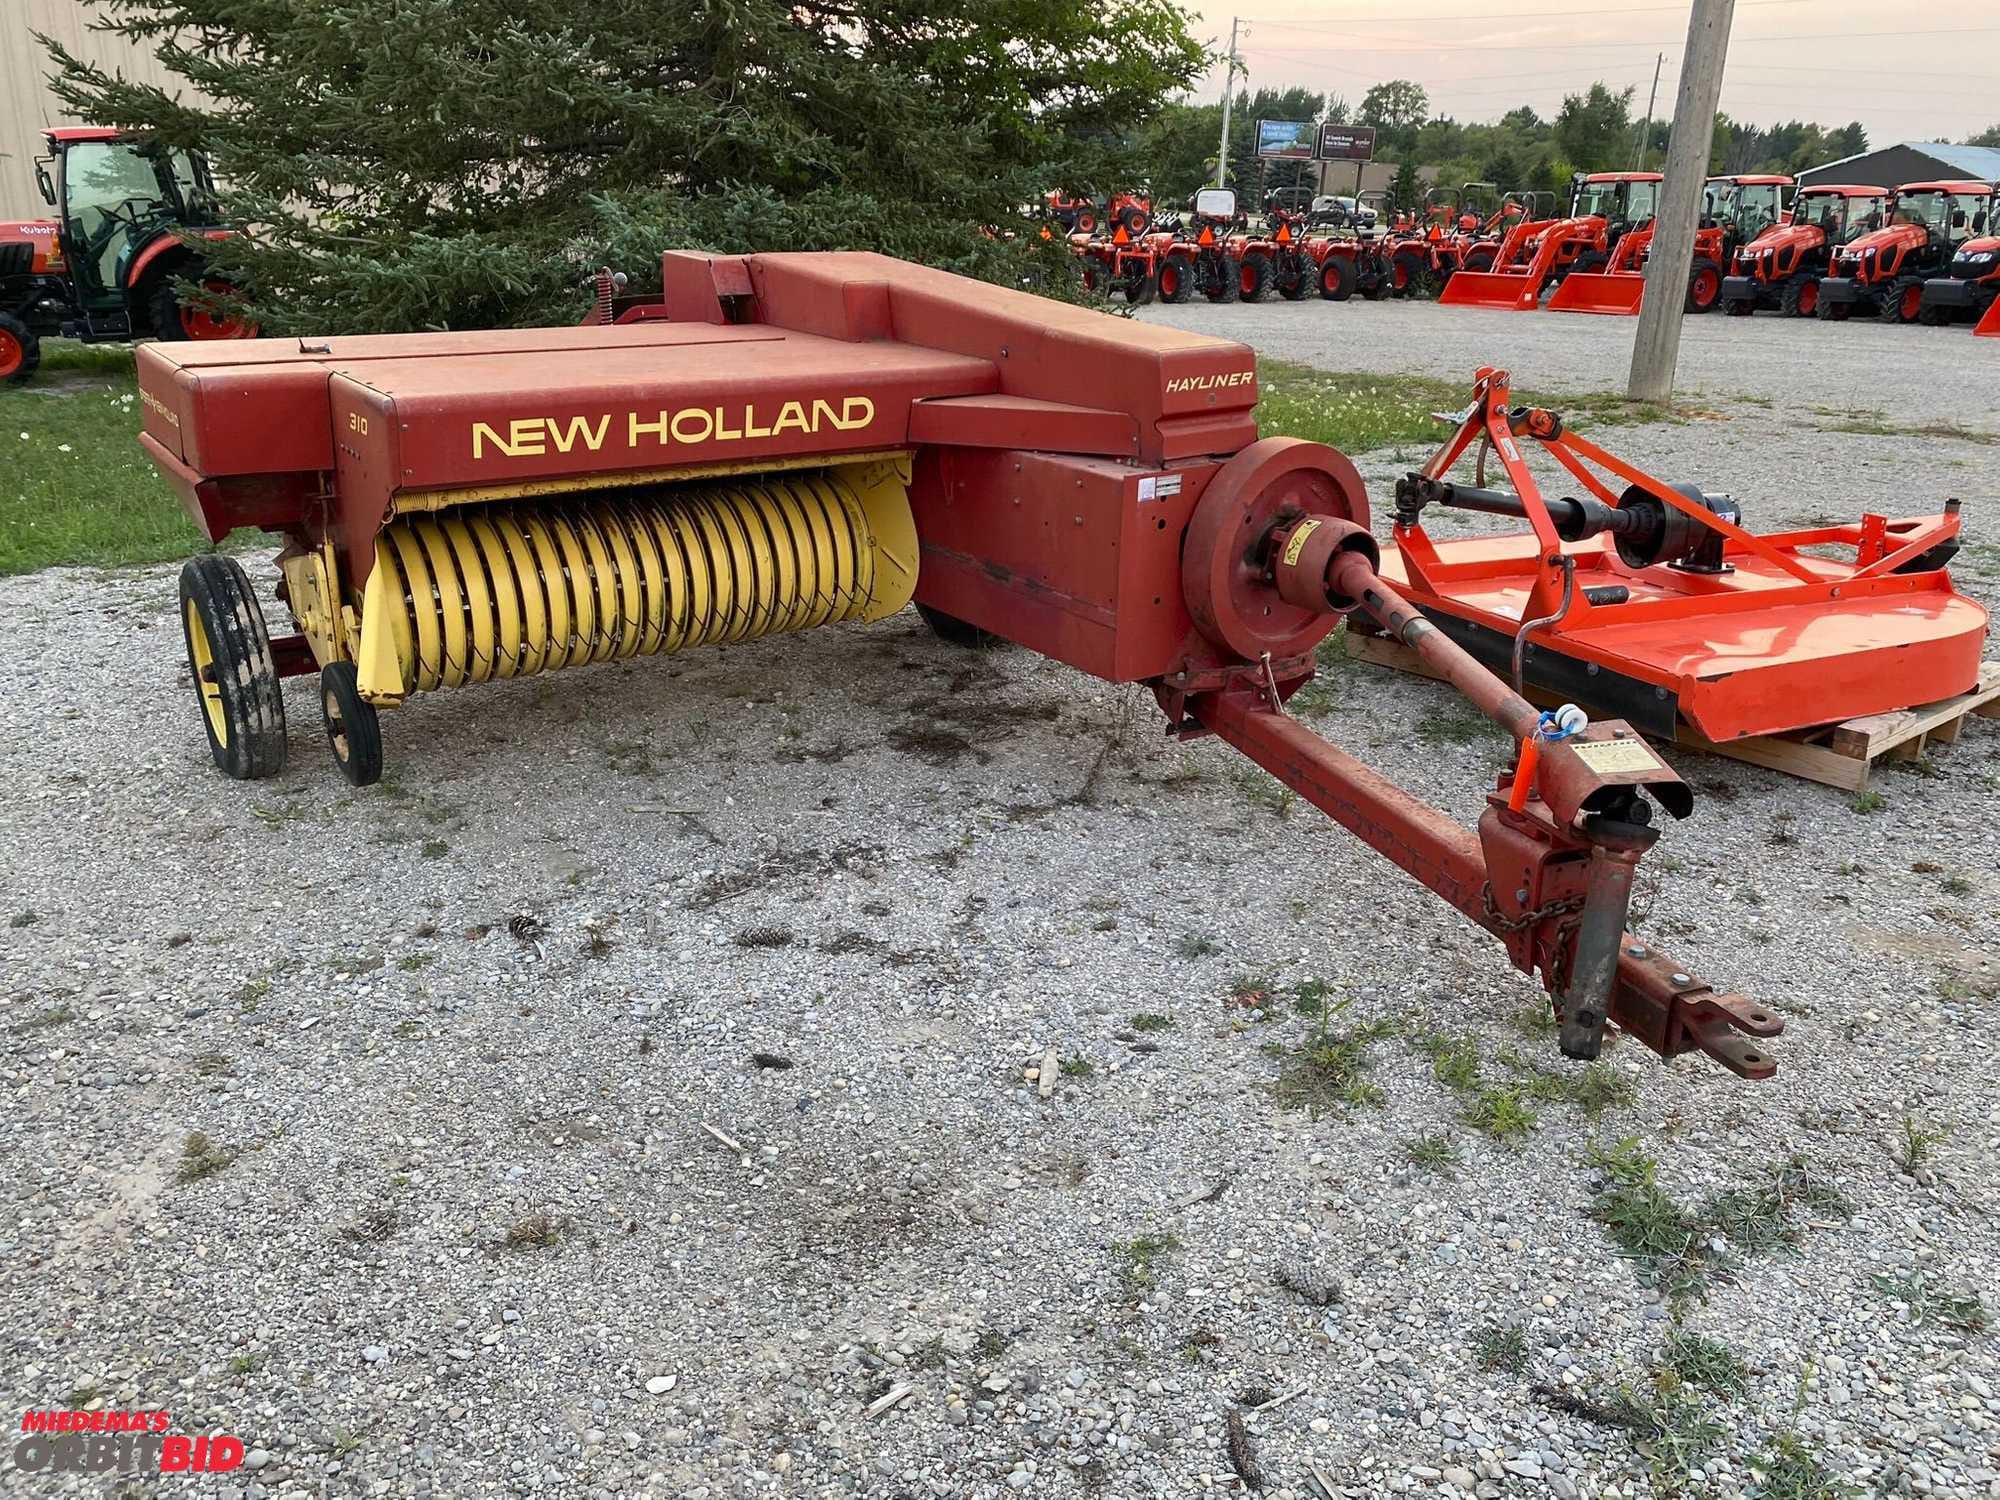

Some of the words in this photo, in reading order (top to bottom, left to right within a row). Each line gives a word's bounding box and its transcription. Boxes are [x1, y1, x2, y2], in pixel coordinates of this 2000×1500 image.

[19, 225, 57, 234] Kubota
[1166, 371, 1254, 393] HAYLINER
[349, 412, 368, 436] 310
[472, 414, 612, 459] NEW
[627, 396, 876, 448] HOLLAND
